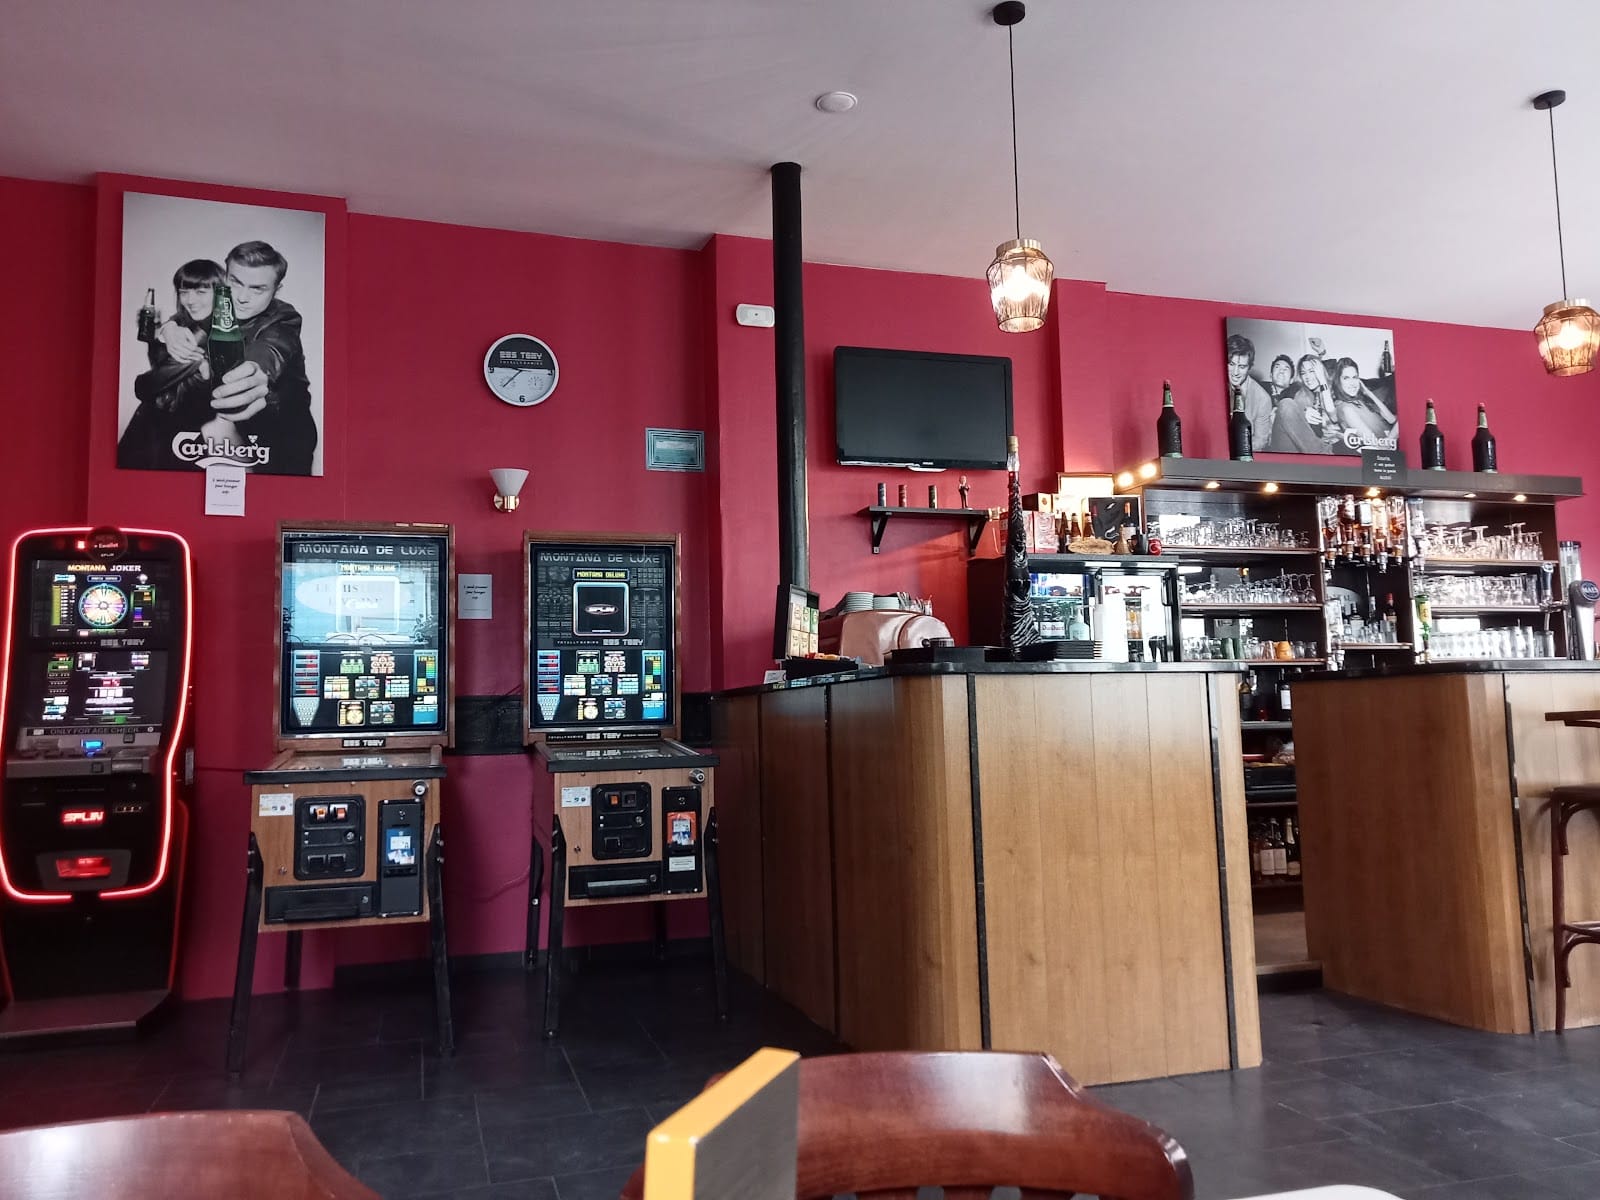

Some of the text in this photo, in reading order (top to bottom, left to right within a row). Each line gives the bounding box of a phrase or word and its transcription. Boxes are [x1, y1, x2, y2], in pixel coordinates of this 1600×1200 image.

[1344, 428, 1396, 451] Carlsberg
[172, 431, 270, 465] Carlsberg
[299, 543, 435, 556] MONTANA DE LUXE
[541, 552, 660, 564] MONTANA DE LUXE
[67, 564, 141, 572] MONTANA JOKER
